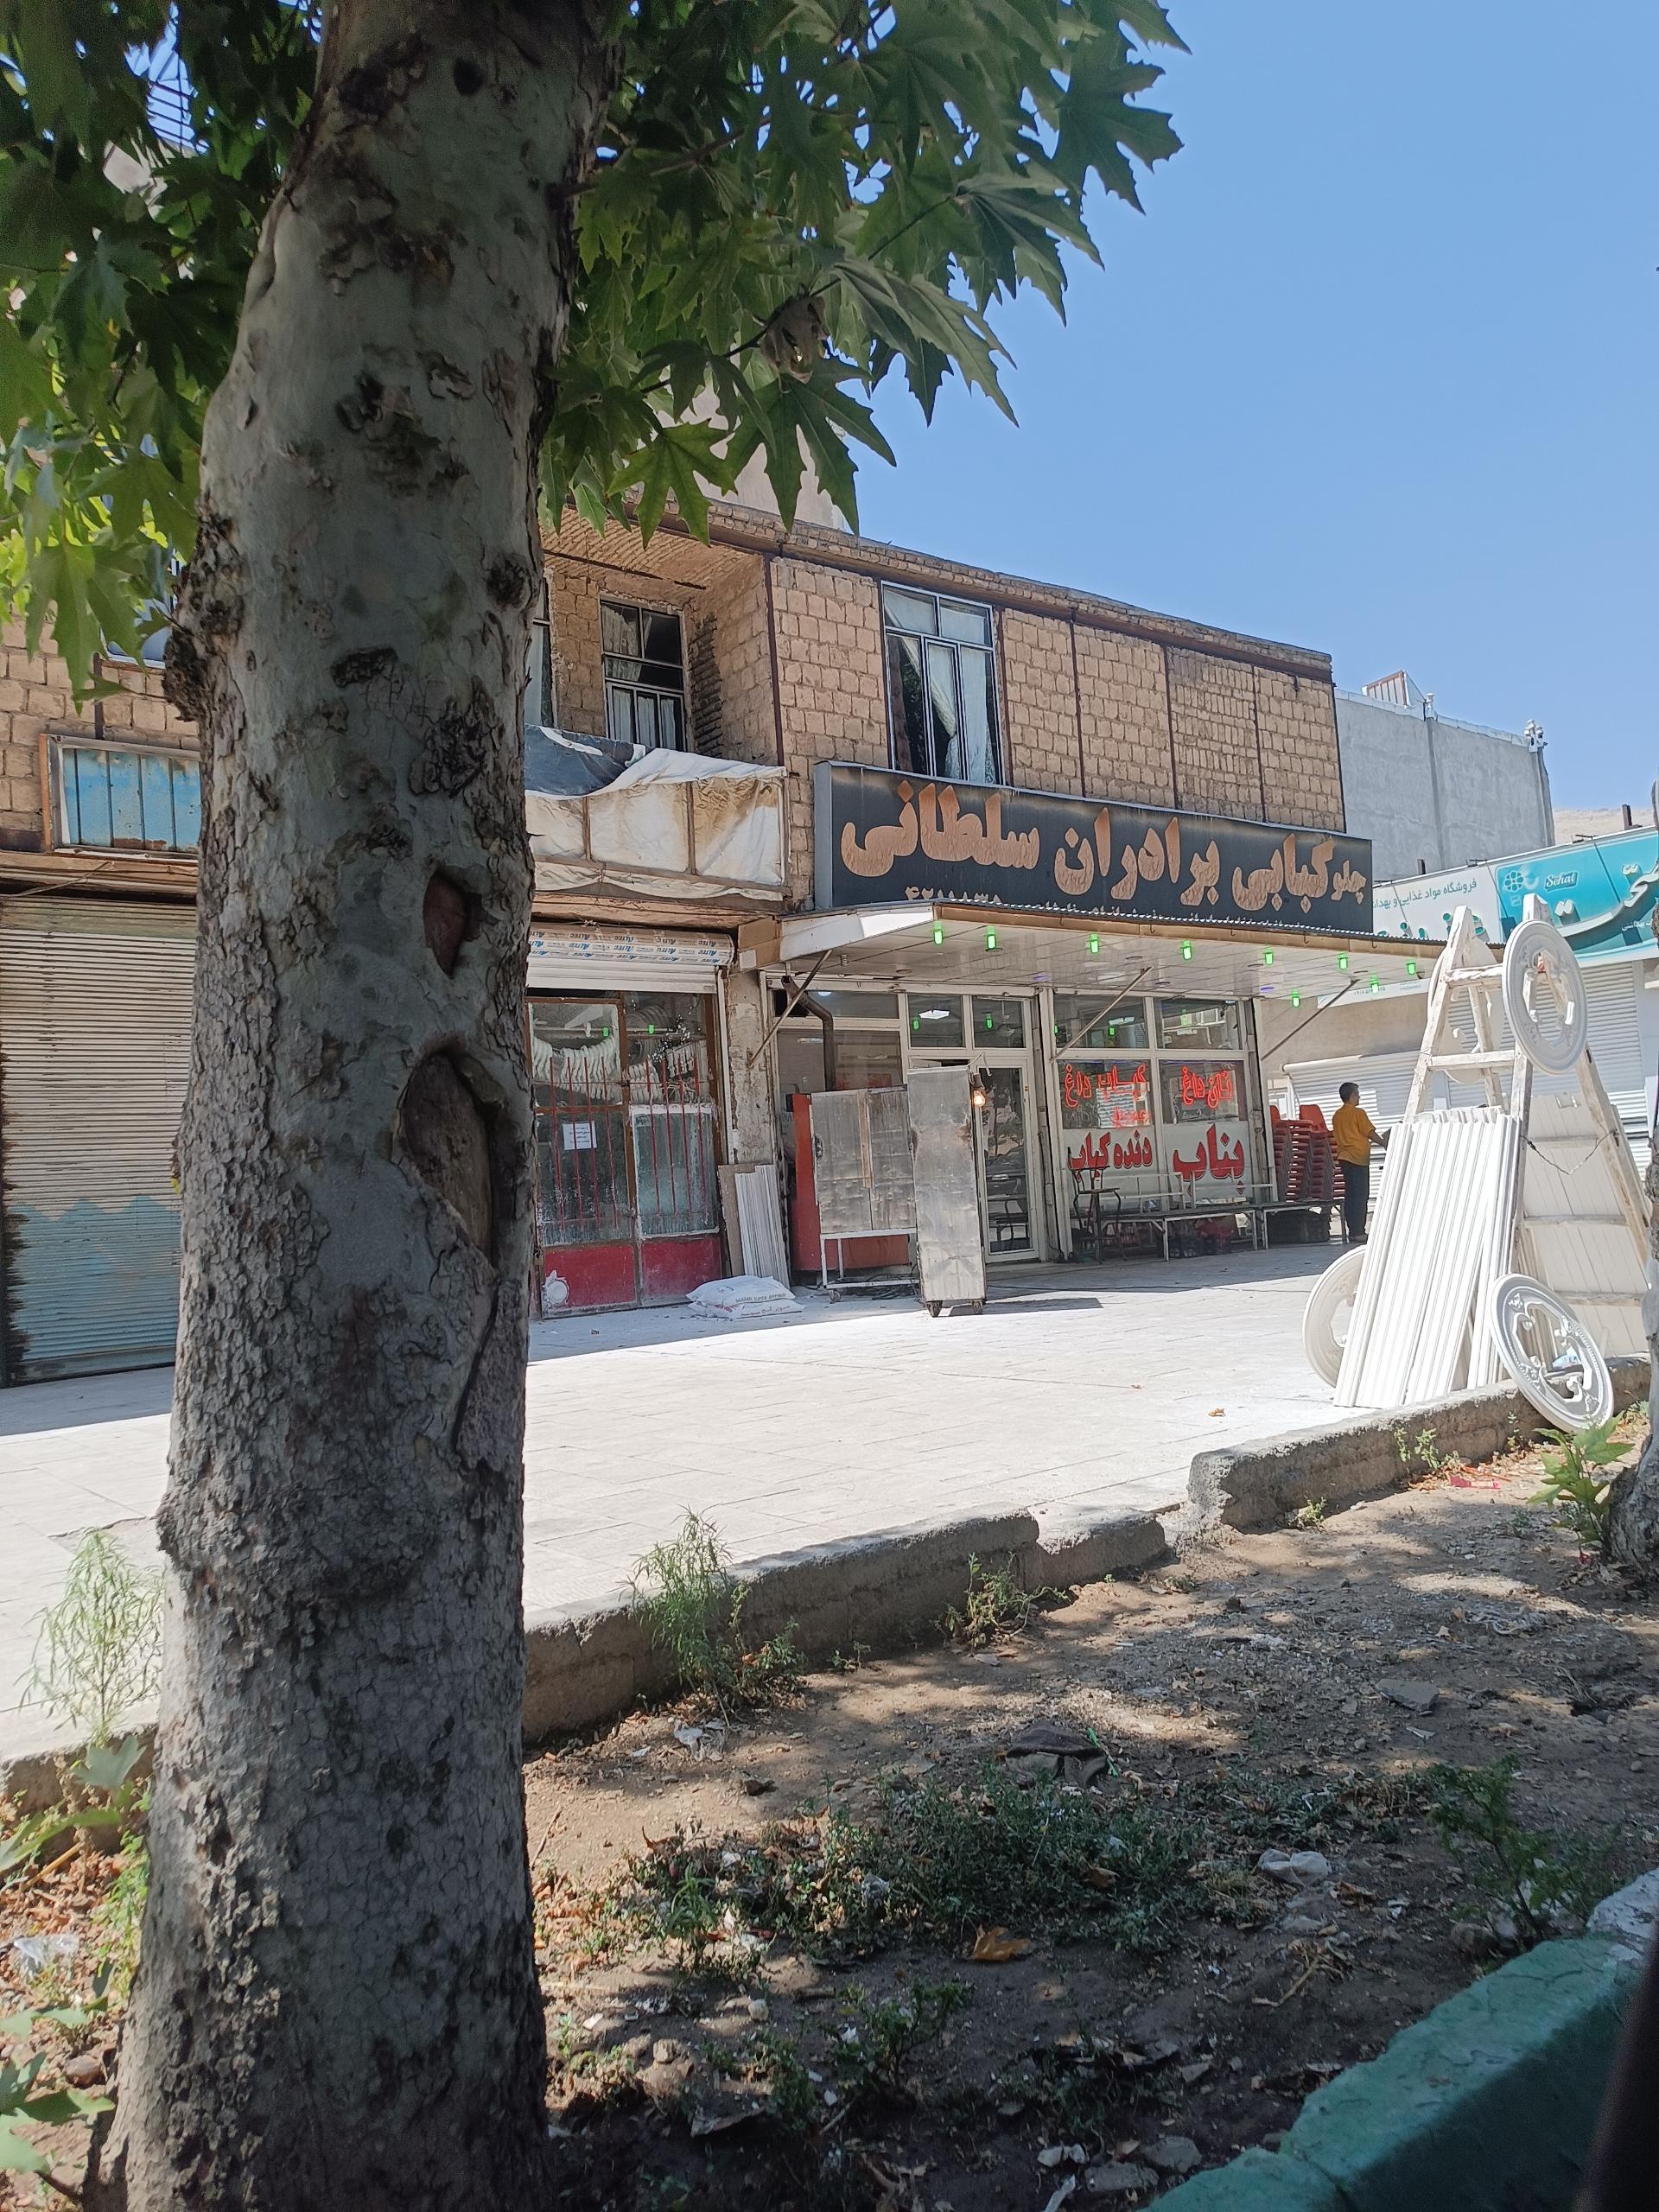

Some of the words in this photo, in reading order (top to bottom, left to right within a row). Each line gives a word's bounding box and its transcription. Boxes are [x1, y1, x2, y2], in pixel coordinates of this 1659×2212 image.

[841, 779, 1040, 878] سلطانی
[1054, 807, 1220, 906] برادران
[1400, 891, 1423, 906] غذایی
[1424, 889, 1442, 899] مواد
[1443, 878, 1478, 894] فروشگاه
[1065, 1063, 1092, 1108] داغ
[1182, 1065, 1205, 1105] داغ
[1207, 1071, 1232, 1109] نان
[1067, 1131, 1110, 1182] کباب
[1113, 1129, 1154, 1169] دنده
[1173, 1123, 1246, 1196] بناب
